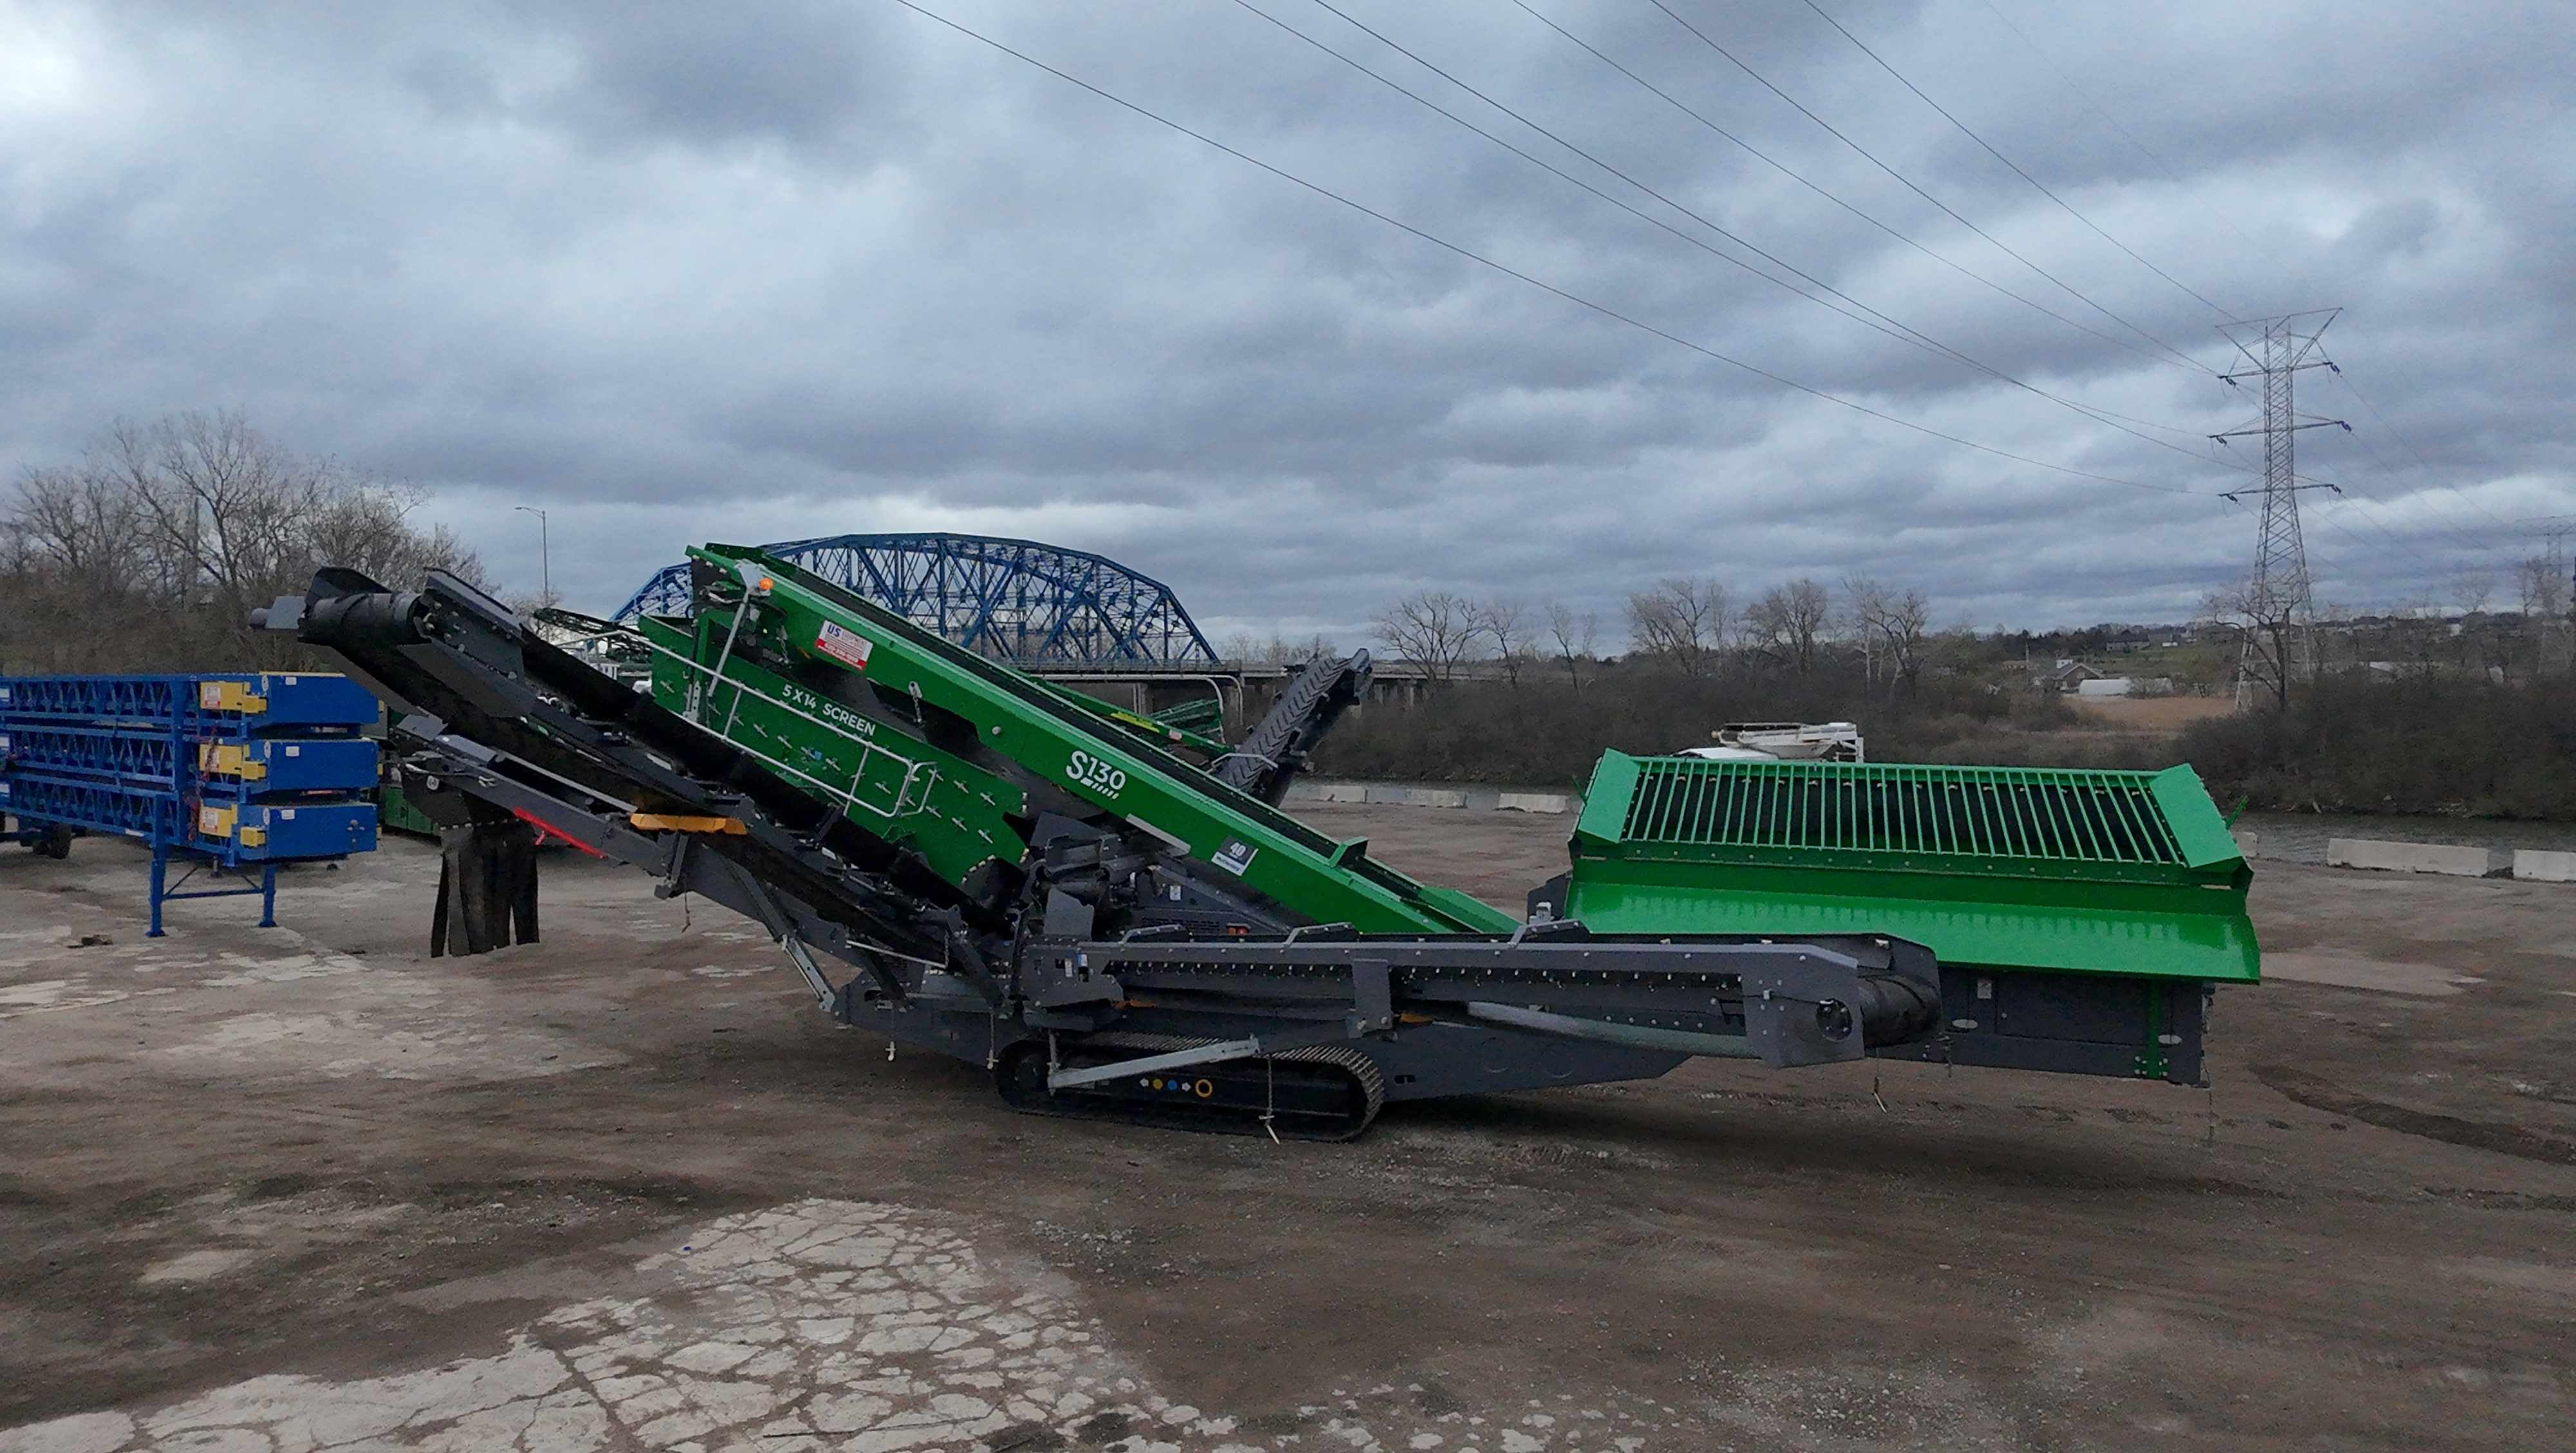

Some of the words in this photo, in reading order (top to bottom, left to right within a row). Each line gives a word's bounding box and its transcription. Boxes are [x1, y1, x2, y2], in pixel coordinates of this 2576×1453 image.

[827, 623, 841, 638] US
[822, 703, 876, 736] SCREEN
[1066, 750, 1126, 790] S130
